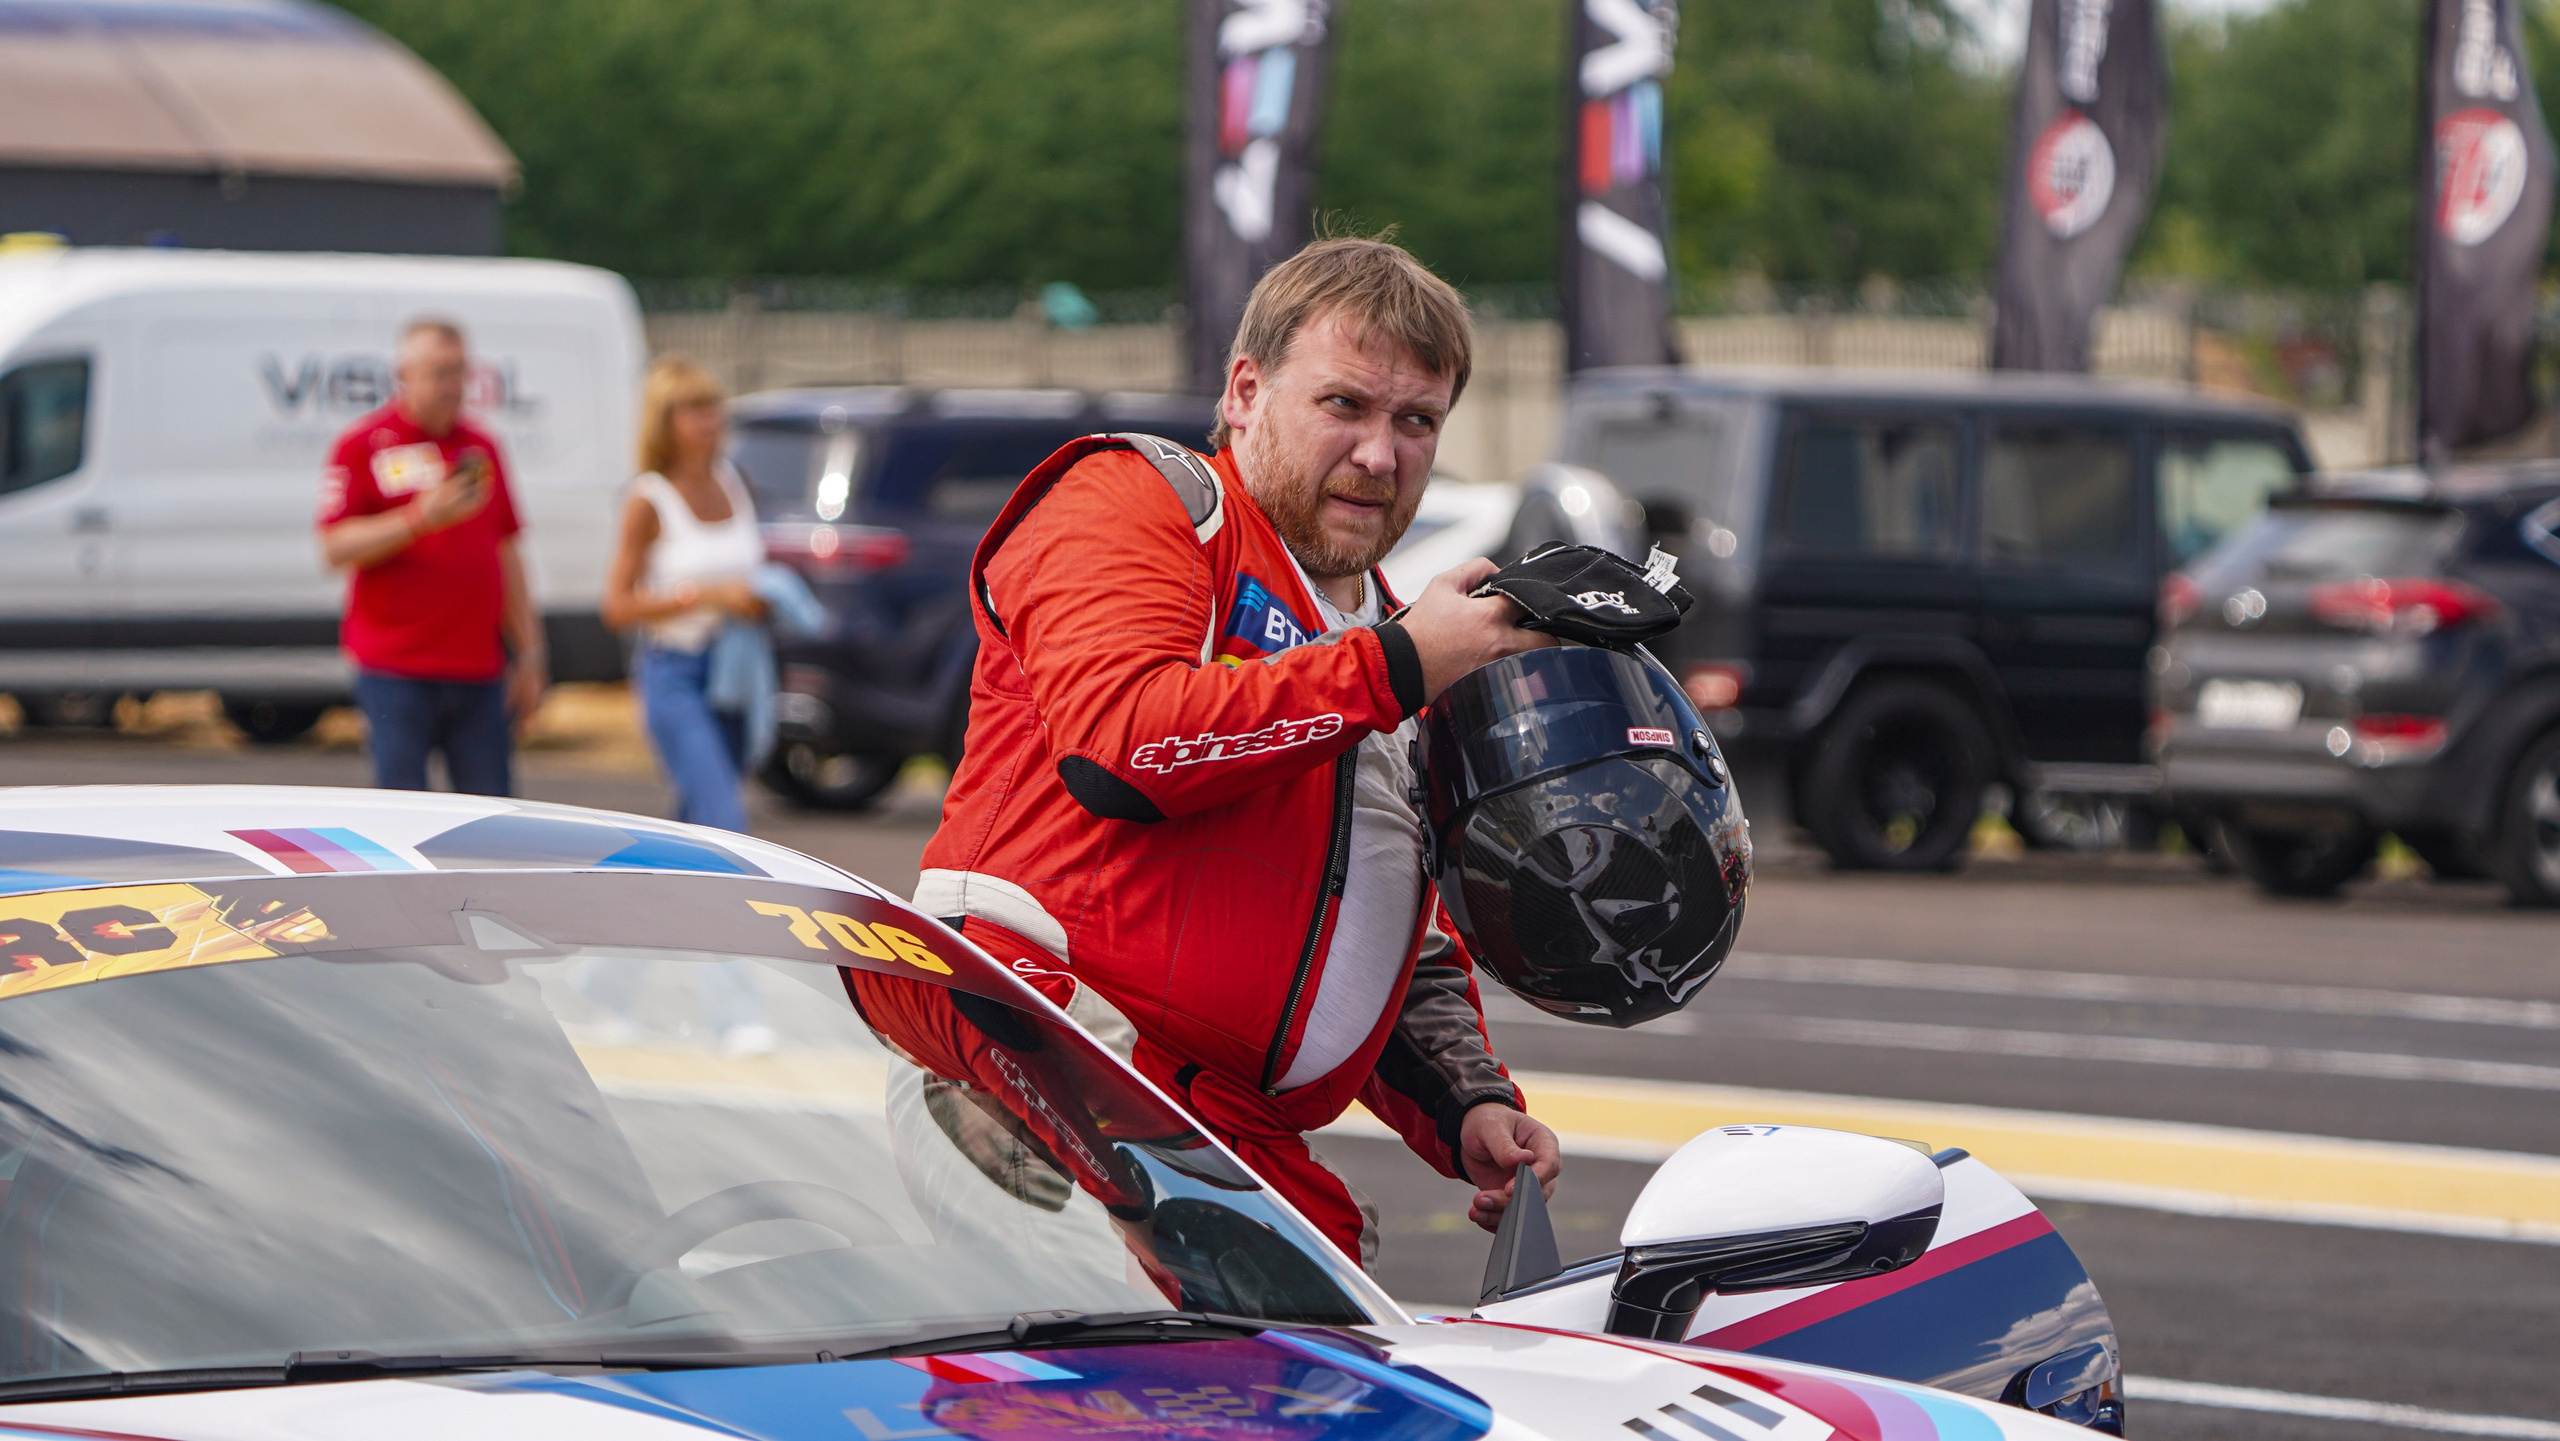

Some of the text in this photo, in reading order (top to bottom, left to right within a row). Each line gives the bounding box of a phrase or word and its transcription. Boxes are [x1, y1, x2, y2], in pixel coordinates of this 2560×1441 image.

[1130, 713, 1344, 774] alpinestars
[1632, 731, 1671, 742] SIMPSON
[745, 899, 954, 976] 706
